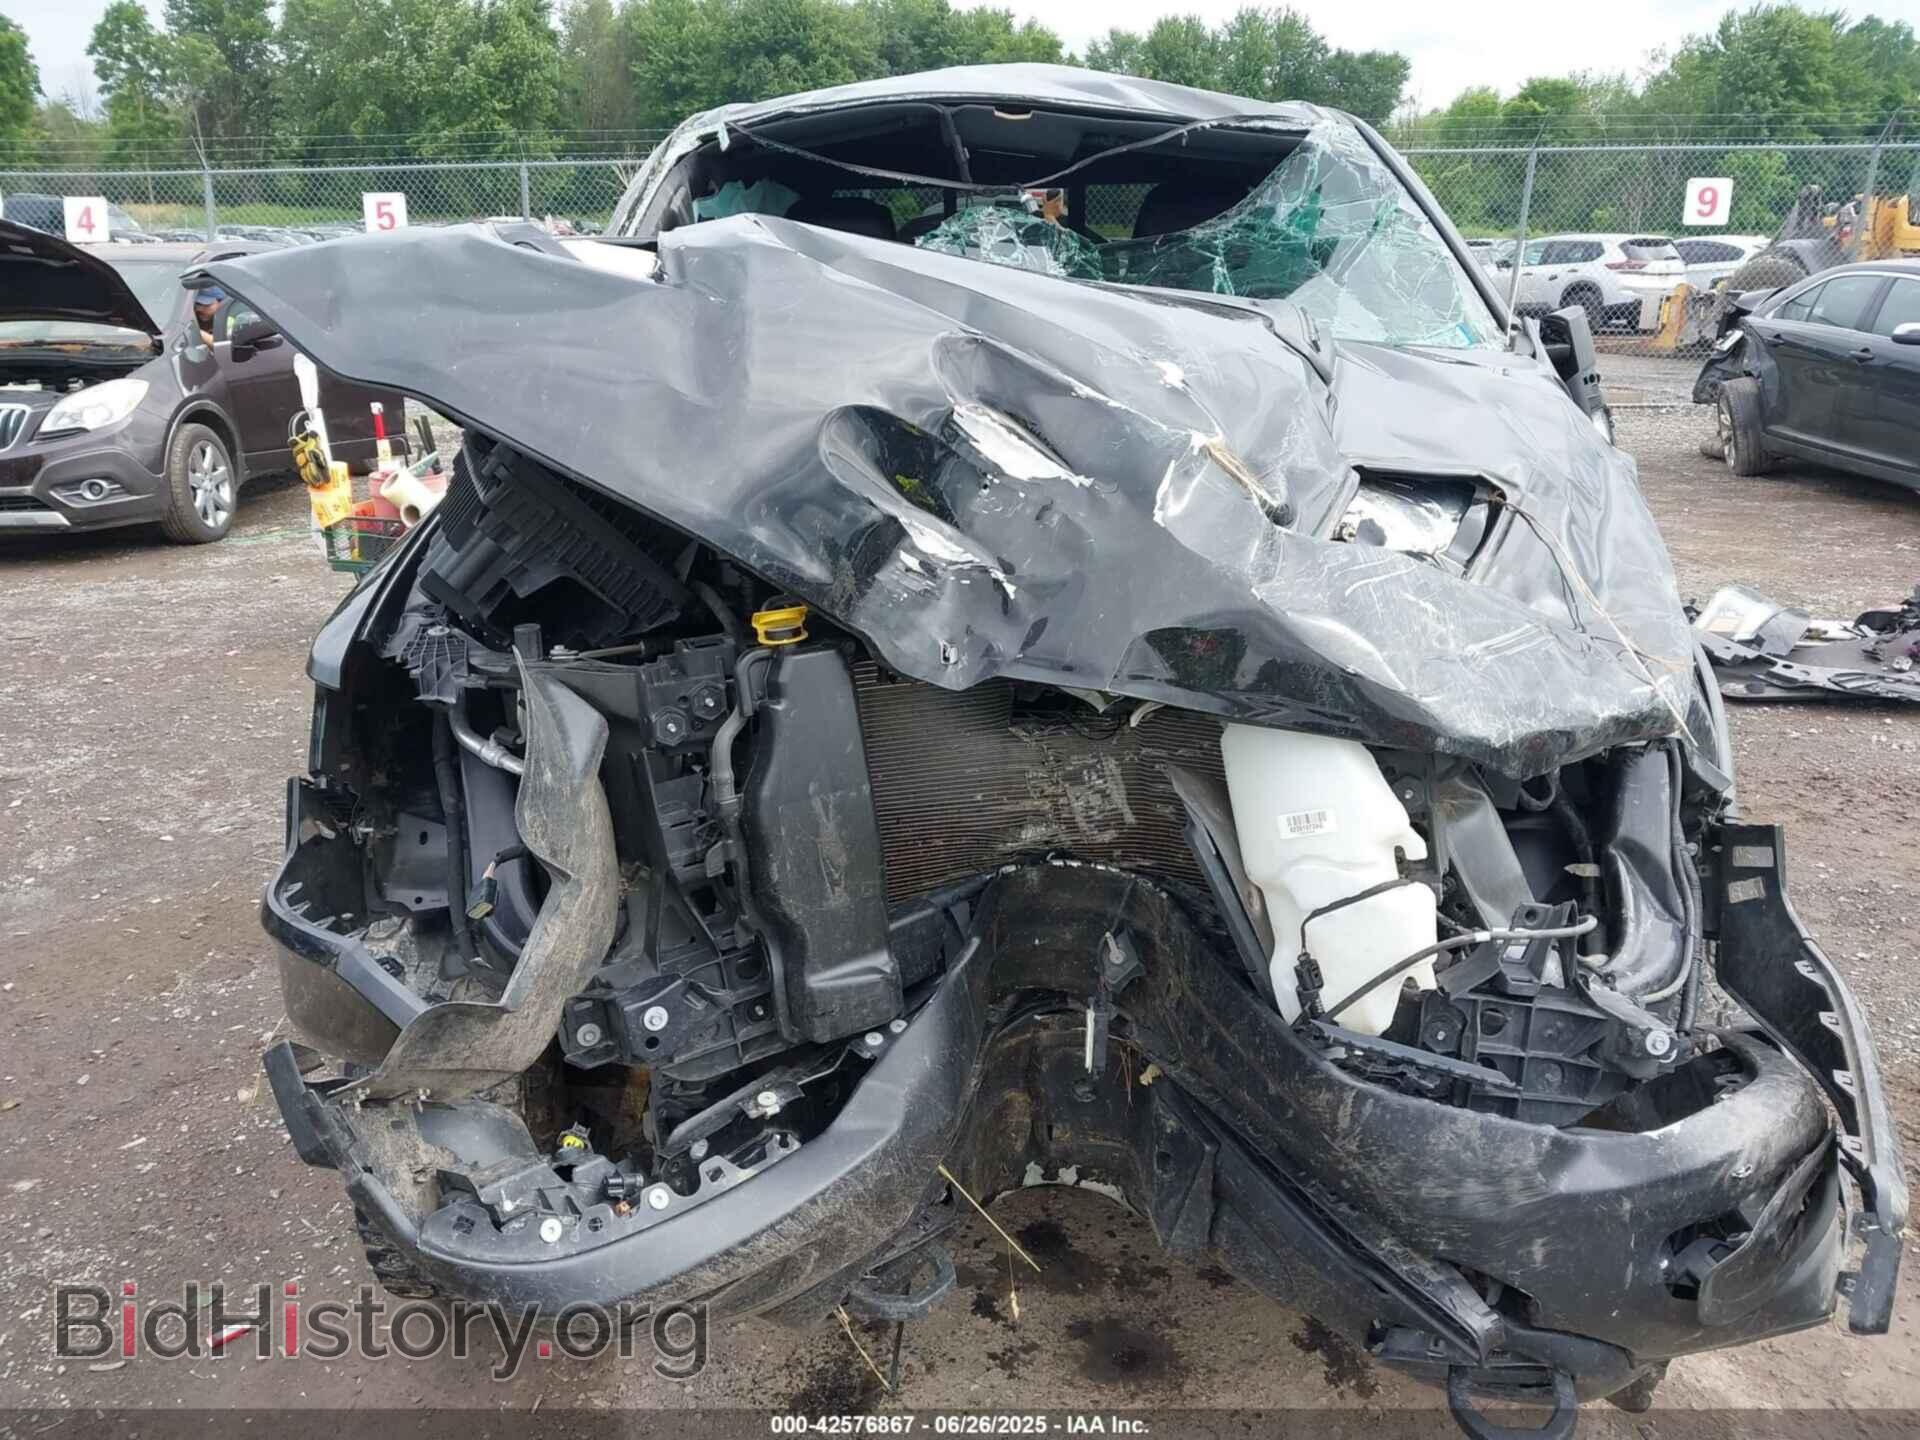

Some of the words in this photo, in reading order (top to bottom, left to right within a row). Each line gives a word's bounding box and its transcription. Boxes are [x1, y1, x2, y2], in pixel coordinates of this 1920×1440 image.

[376, 201, 396, 231] 5
[1697, 186, 1718, 218] 9
[77, 206, 96, 234] 4
